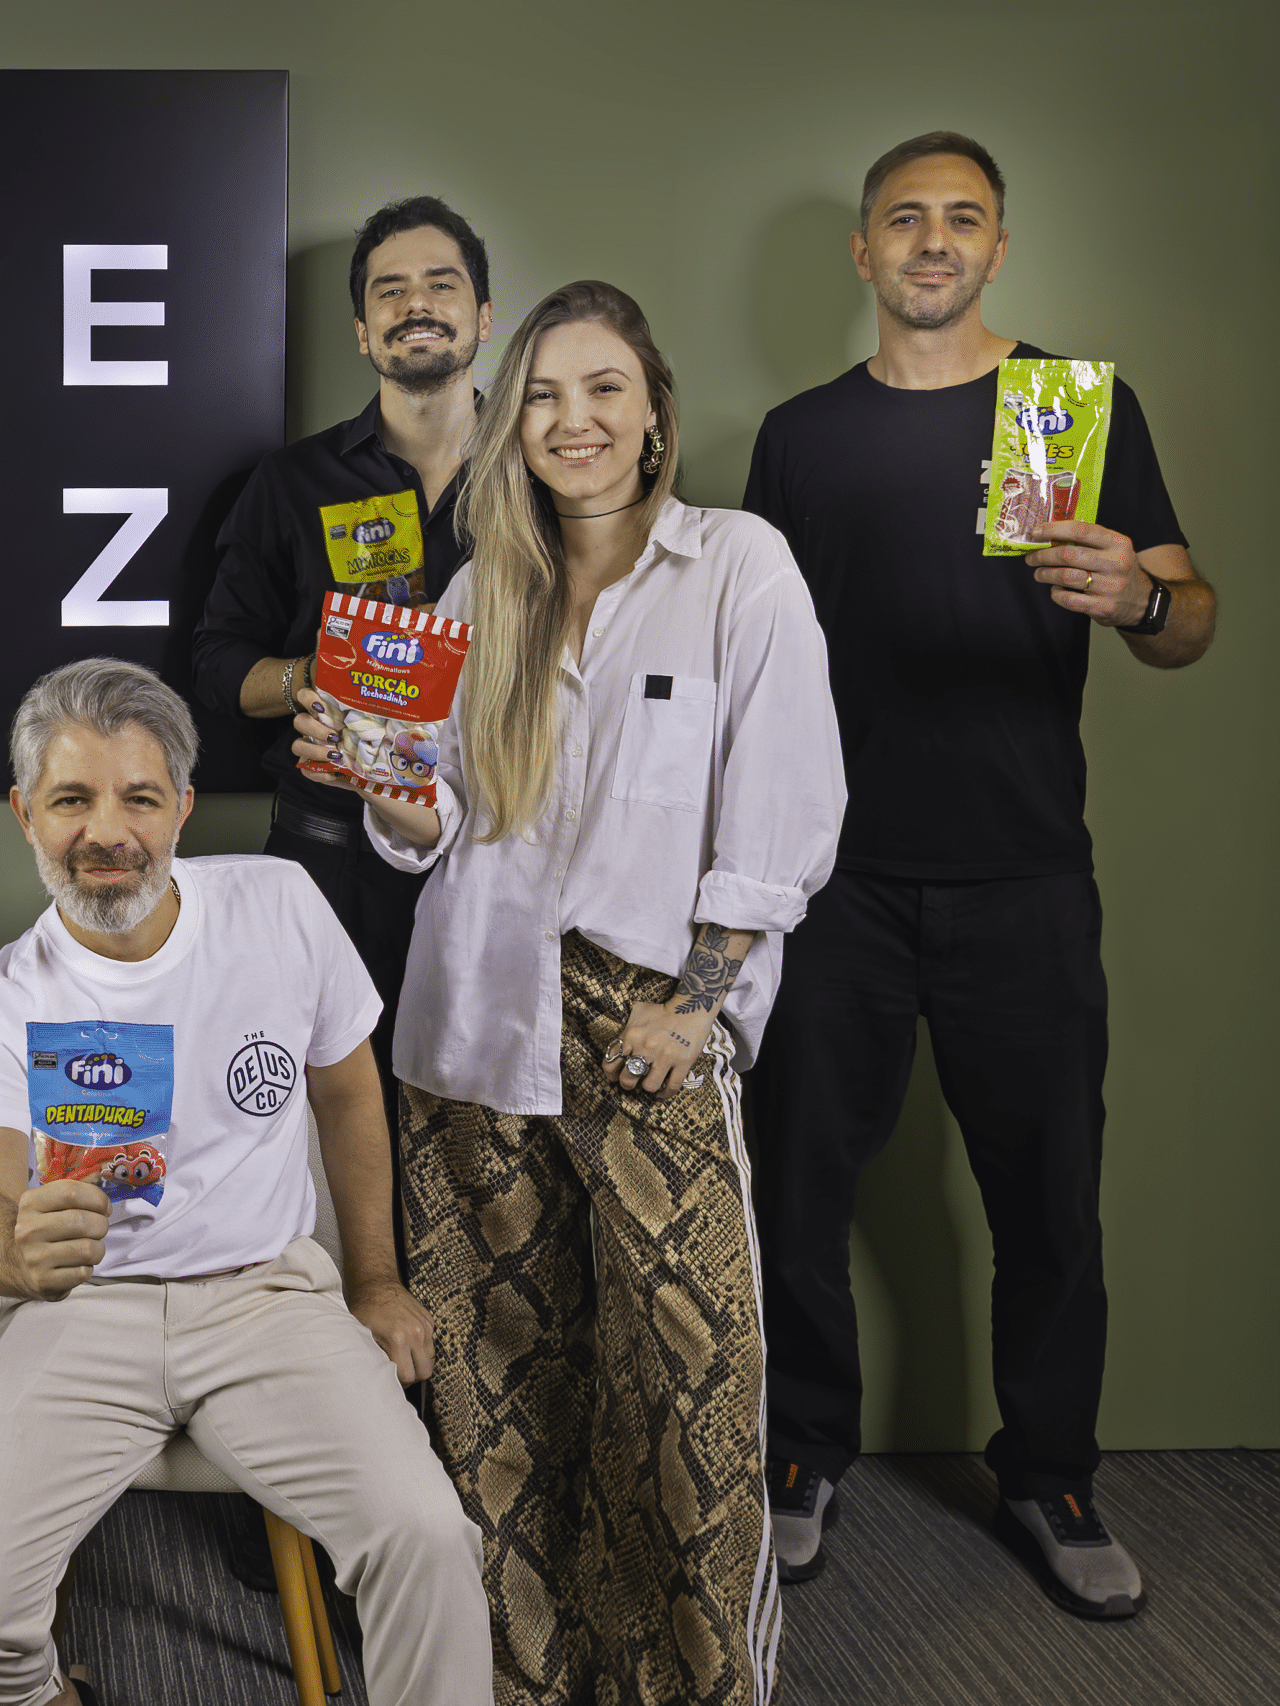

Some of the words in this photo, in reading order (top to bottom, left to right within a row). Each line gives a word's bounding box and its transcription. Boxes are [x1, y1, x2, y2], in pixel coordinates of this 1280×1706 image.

[356, 519, 391, 542] Fini
[366, 635, 419, 664] Fini
[350, 670, 420, 700] TORÇÃO
[244, 1030, 265, 1042] THE
[72, 1058, 124, 1085] Fini
[255, 1089, 282, 1111] CO.
[46, 1103, 146, 1129] DENTADURAS
